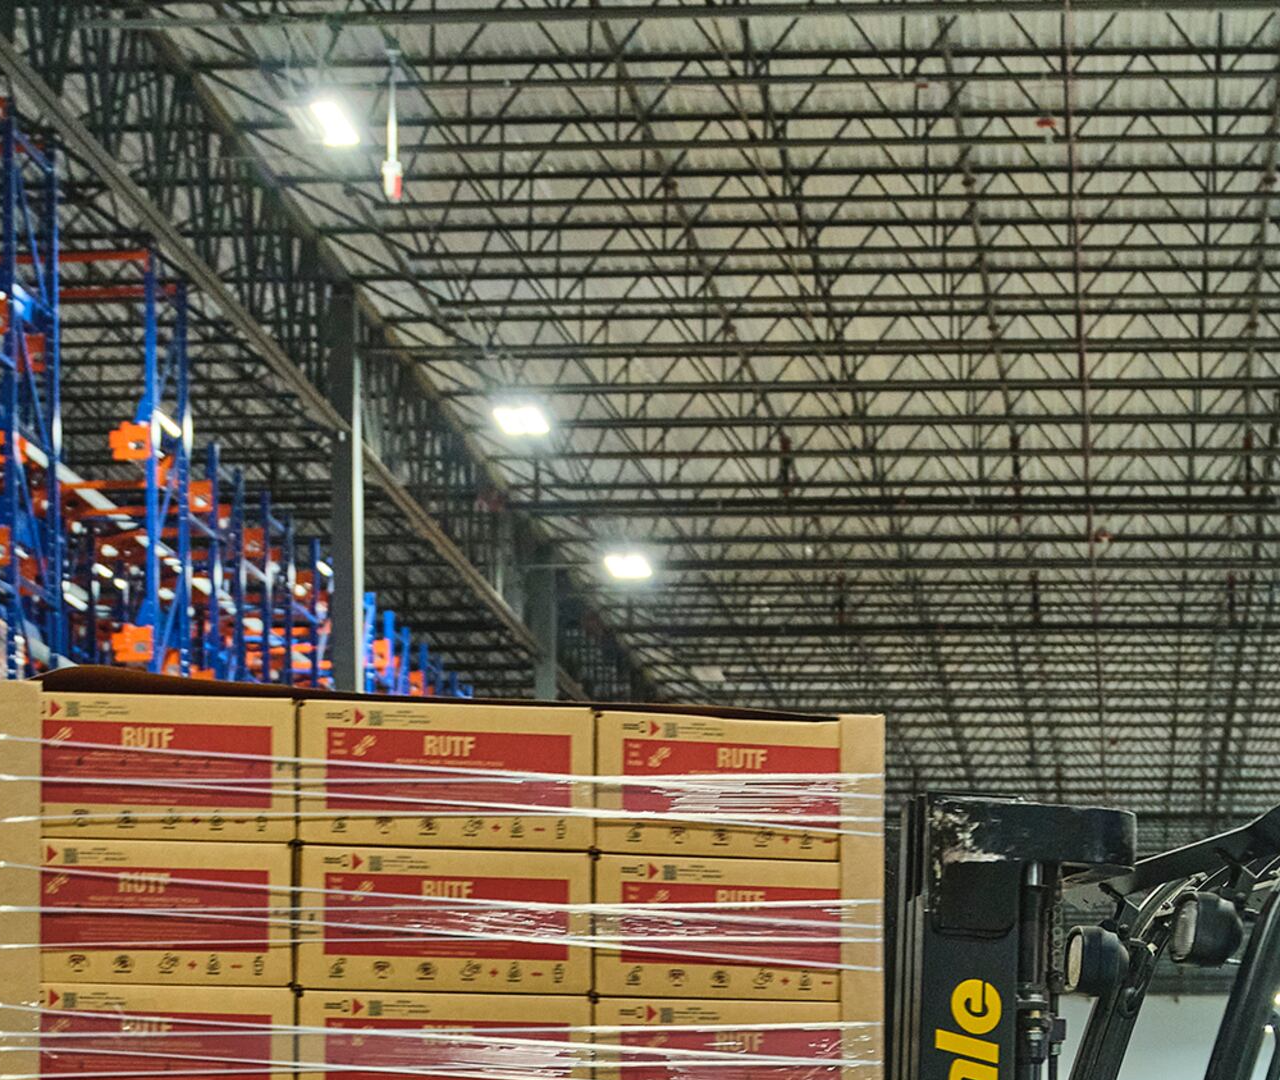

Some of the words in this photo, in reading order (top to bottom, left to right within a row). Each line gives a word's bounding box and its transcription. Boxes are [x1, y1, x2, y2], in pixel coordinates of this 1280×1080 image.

[120, 726, 174, 748] RUTF
[423, 735, 477, 757] RUTF
[717, 747, 768, 769] RUTF
[715, 1032, 765, 1052] RUTF
